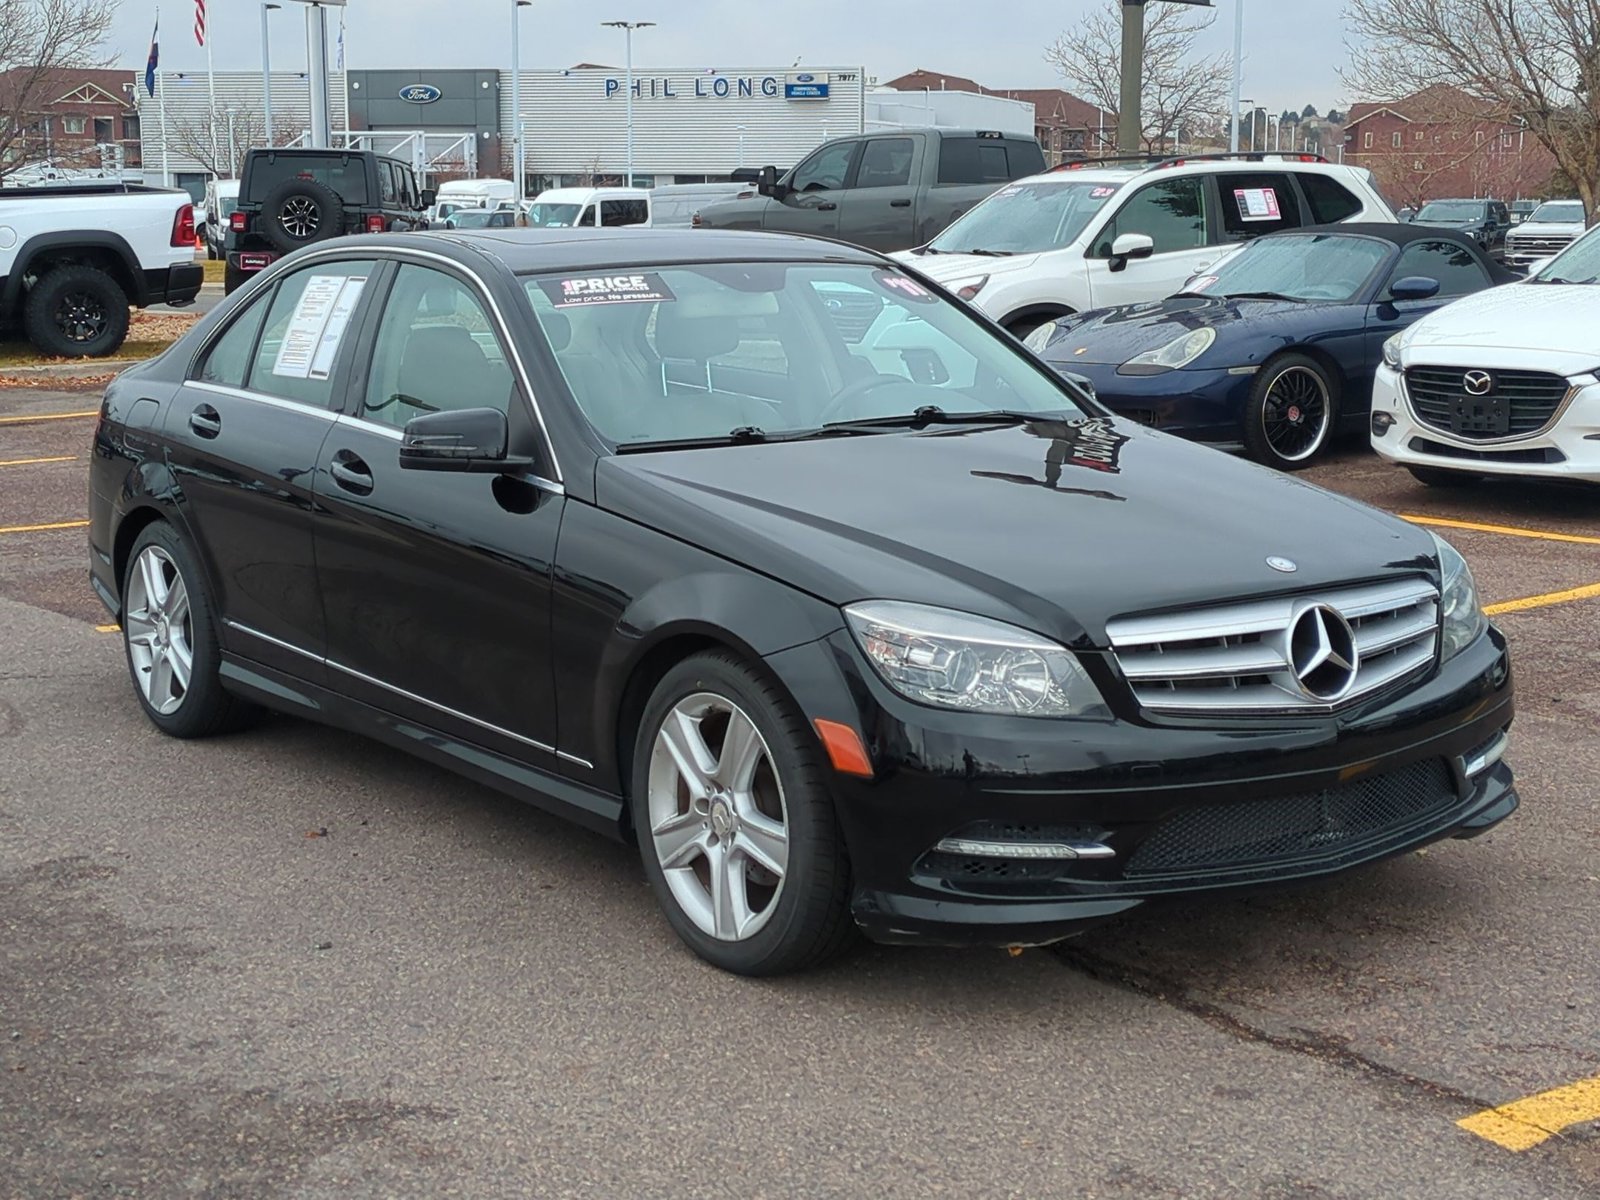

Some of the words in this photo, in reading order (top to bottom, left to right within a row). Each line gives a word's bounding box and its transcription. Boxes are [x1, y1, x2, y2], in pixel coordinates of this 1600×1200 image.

[604, 78, 677, 98] PHIL
[694, 76, 779, 97] LONG
[561, 275, 648, 291] 1PRICE
[584, 295, 607, 303] price.
[623, 292, 663, 300] pressure.
